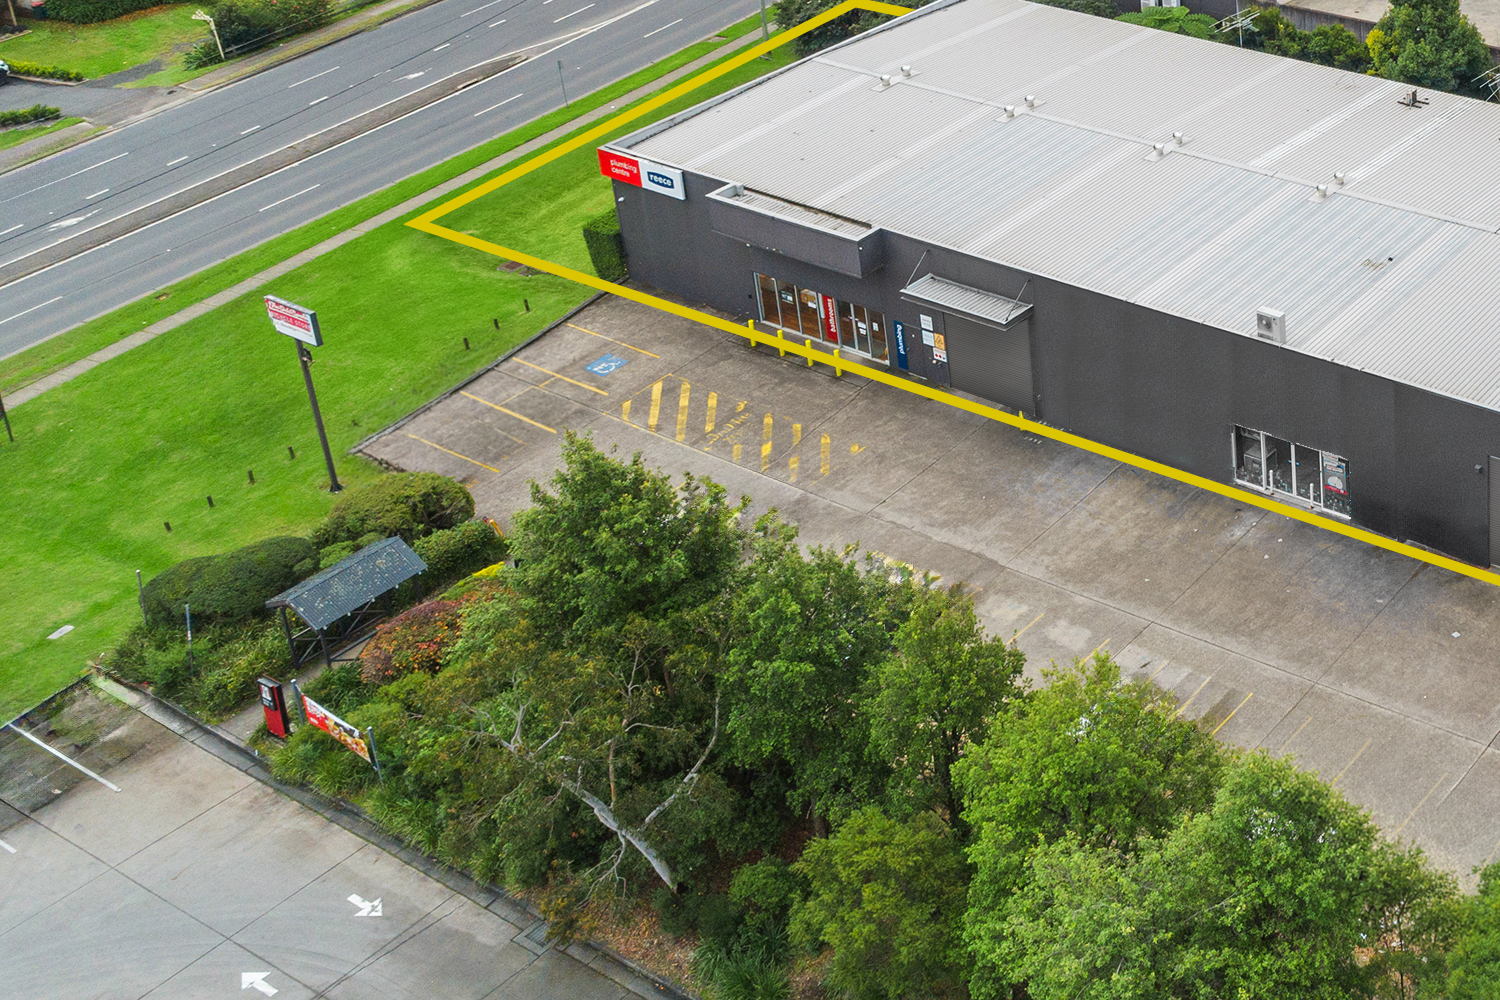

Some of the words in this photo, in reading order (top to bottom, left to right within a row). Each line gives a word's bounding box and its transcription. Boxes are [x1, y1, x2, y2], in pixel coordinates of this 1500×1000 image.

[610, 159, 638, 173] plumbing
[611, 167, 631, 178] centre
[649, 173, 672, 187] reece
[827, 298, 837, 332] bathrooms
[896, 323, 905, 355] plumbing
